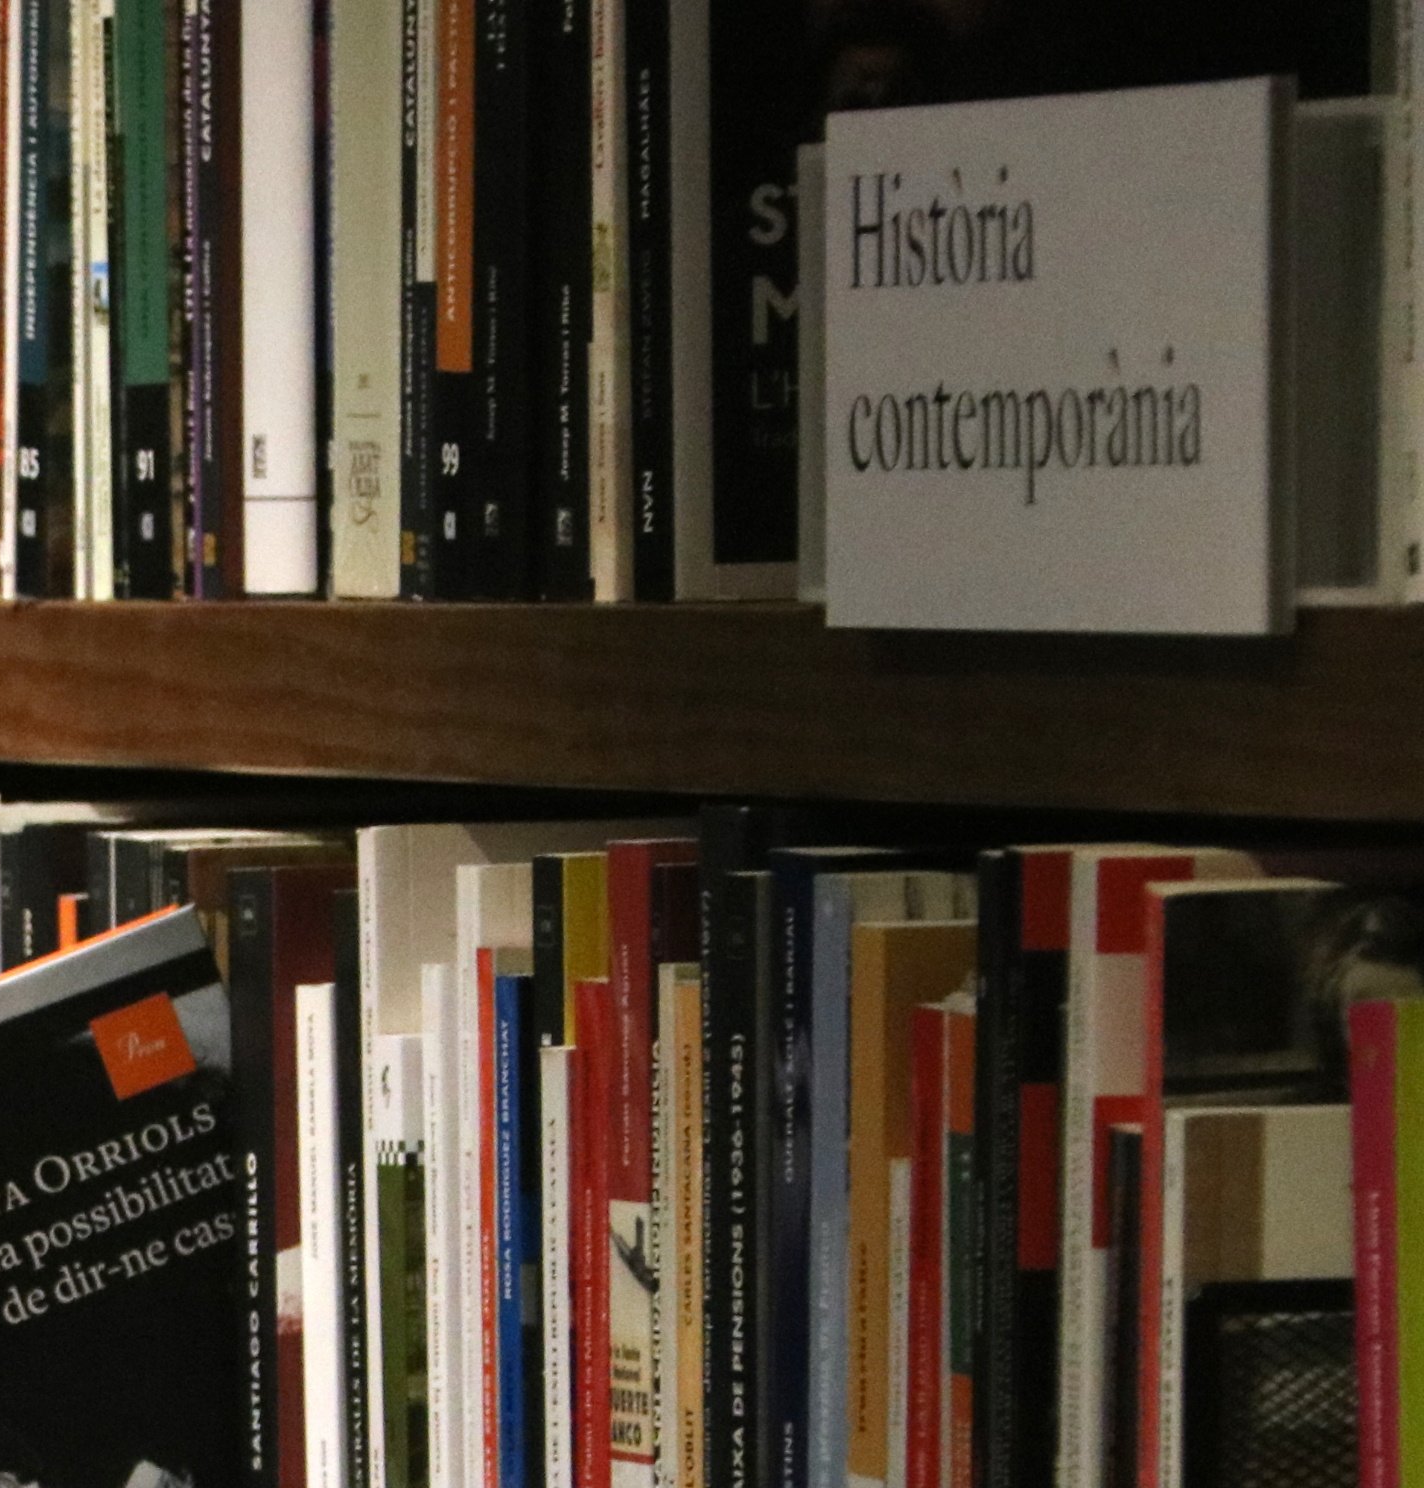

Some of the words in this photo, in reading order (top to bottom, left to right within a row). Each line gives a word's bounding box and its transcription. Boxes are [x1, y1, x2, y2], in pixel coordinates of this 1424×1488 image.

[636, 67, 653, 221] MAGALHÃES
[24, 152, 39, 341] INDEPENDÈNCIA
[445, 114, 458, 322] ANTICORRUPCIÓ
[850, 167, 1037, 290] Història
[21, 447, 40, 481] 85
[136, 448, 156, 480] 91
[441, 442, 460, 477] 99
[849, 348, 1203, 505] contemporània
[783, 905, 796, 994] BARJAU
[498, 1019, 512, 1125] BRANCHAT
[783, 1017, 796, 1074] SOLÉ
[33, 1102, 218, 1194] ORRIOLS
[729, 1031, 747, 1215] (1936-1945)
[783, 1083, 796, 1183] QUERALT
[24, 1152, 237, 1270] possibilitat
[246, 1150, 261, 1299] CARRILLO
[308, 1145, 319, 1214] MANUEL
[345, 1161, 359, 1287] MEMÒRIA
[682, 1125, 693, 1244] SANTACANA
[1, 1285, 50, 1326] de
[52, 1238, 170, 1305] dir-ne
[173, 1211, 237, 1257] cas
[349, 1295, 360, 1326] LA
[502, 1248, 514, 1300] ROSA
[682, 1251, 694, 1326] CARLES
[730, 1223, 745, 1372] PENSIONS
[248, 1308, 264, 1472] SANTIAGO
[350, 1334, 361, 1369] DE
[731, 1380, 745, 1417] DE
[550, 1434, 560, 1464] DE
[583, 1389, 594, 1418] de
[683, 1407, 696, 1488] L'OBLIT
